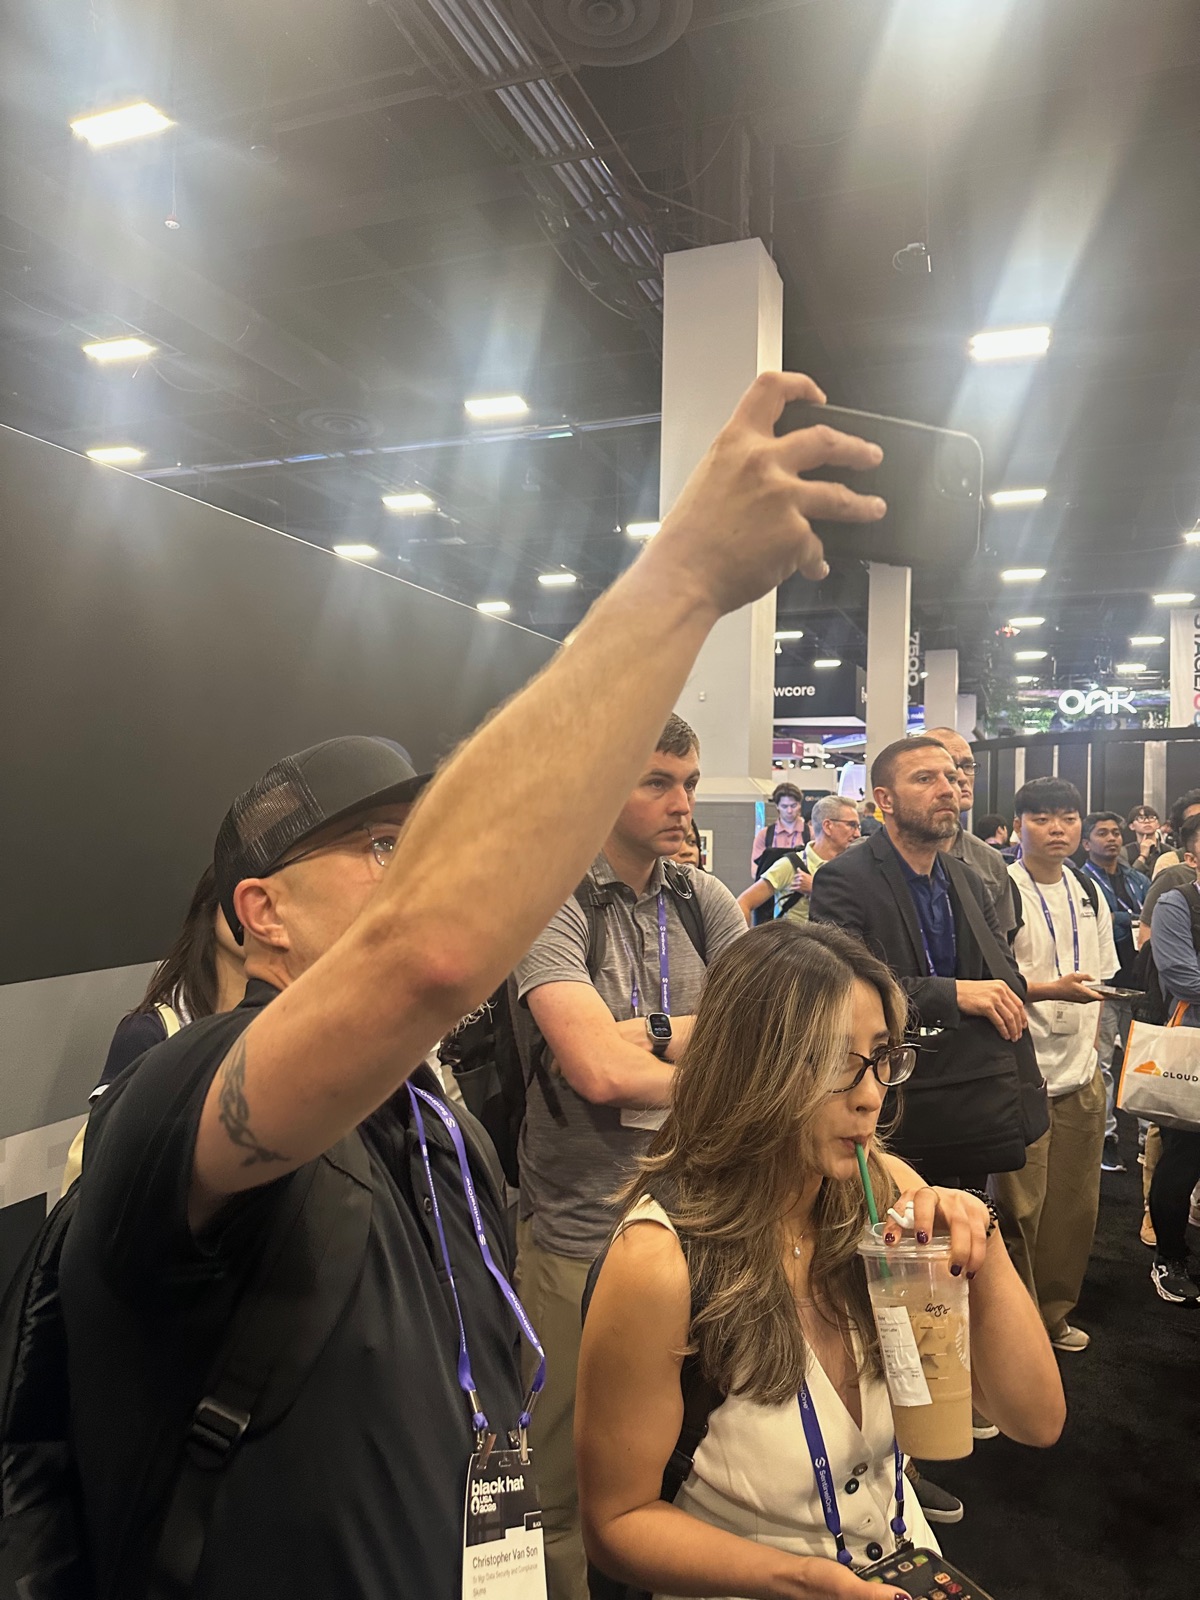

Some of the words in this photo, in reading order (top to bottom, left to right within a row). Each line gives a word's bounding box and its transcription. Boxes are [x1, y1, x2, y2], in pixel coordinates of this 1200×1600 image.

[1162, 1071, 1199, 1082] CLOUD
[466, 1176, 482, 1232] SentinelOne
[508, 1291, 539, 1344] SentinelOne
[471, 1477, 505, 1496] black
[506, 1474, 525, 1492] hat
[819, 1470, 832, 1514] SentinelOne
[472, 1552, 511, 1569] Christopher
[512, 1548, 526, 1560] Van
[526, 1546, 538, 1558] Son
